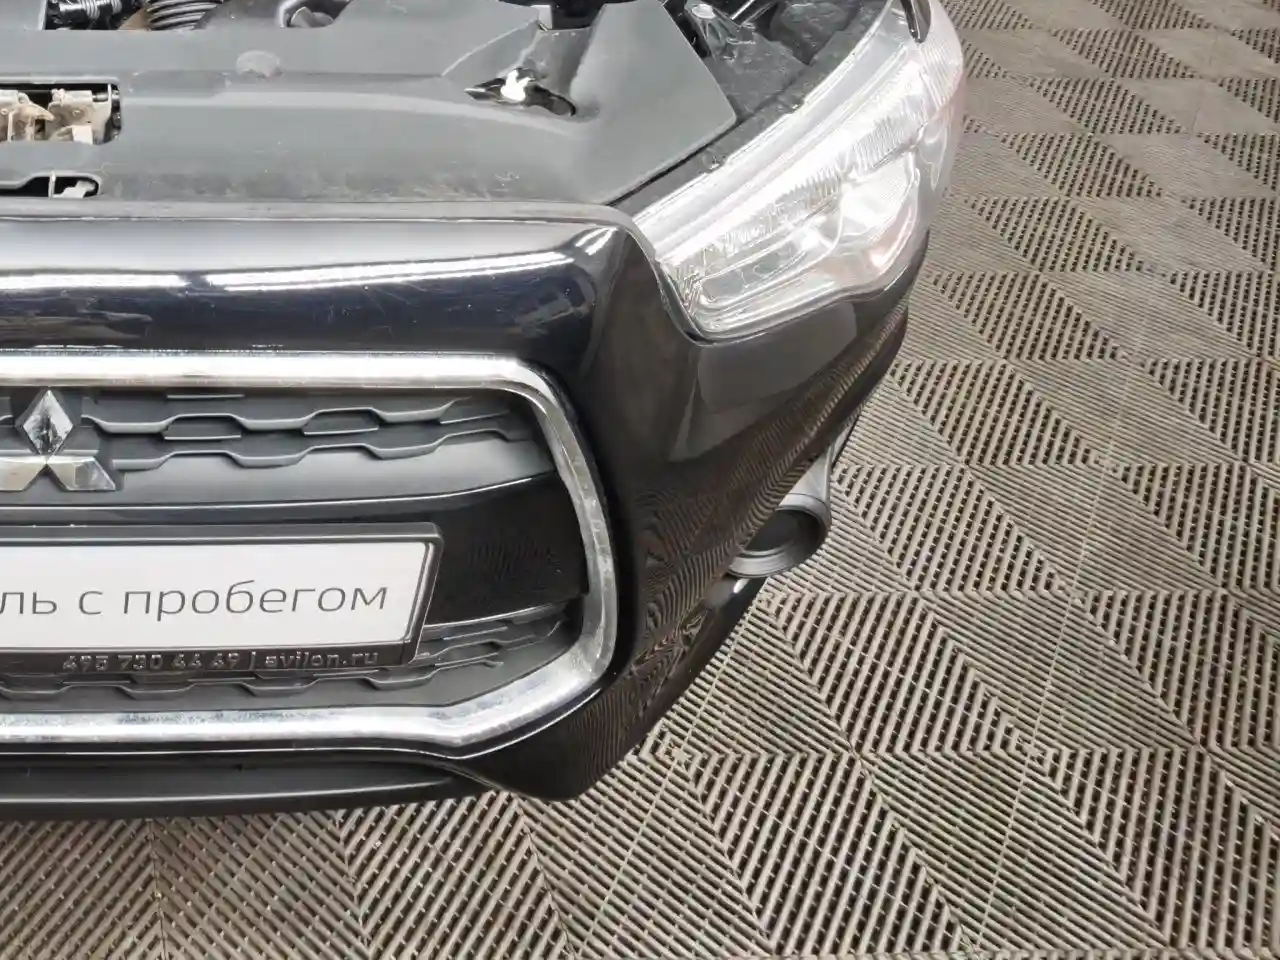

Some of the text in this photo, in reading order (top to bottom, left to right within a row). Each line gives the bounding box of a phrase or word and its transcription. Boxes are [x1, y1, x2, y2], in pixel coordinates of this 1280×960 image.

[78, 590, 103, 615] с
[122, 579, 389, 623] пробегом
[117, 653, 163, 671] 730
[264, 650, 379, 670] avilon.ru
